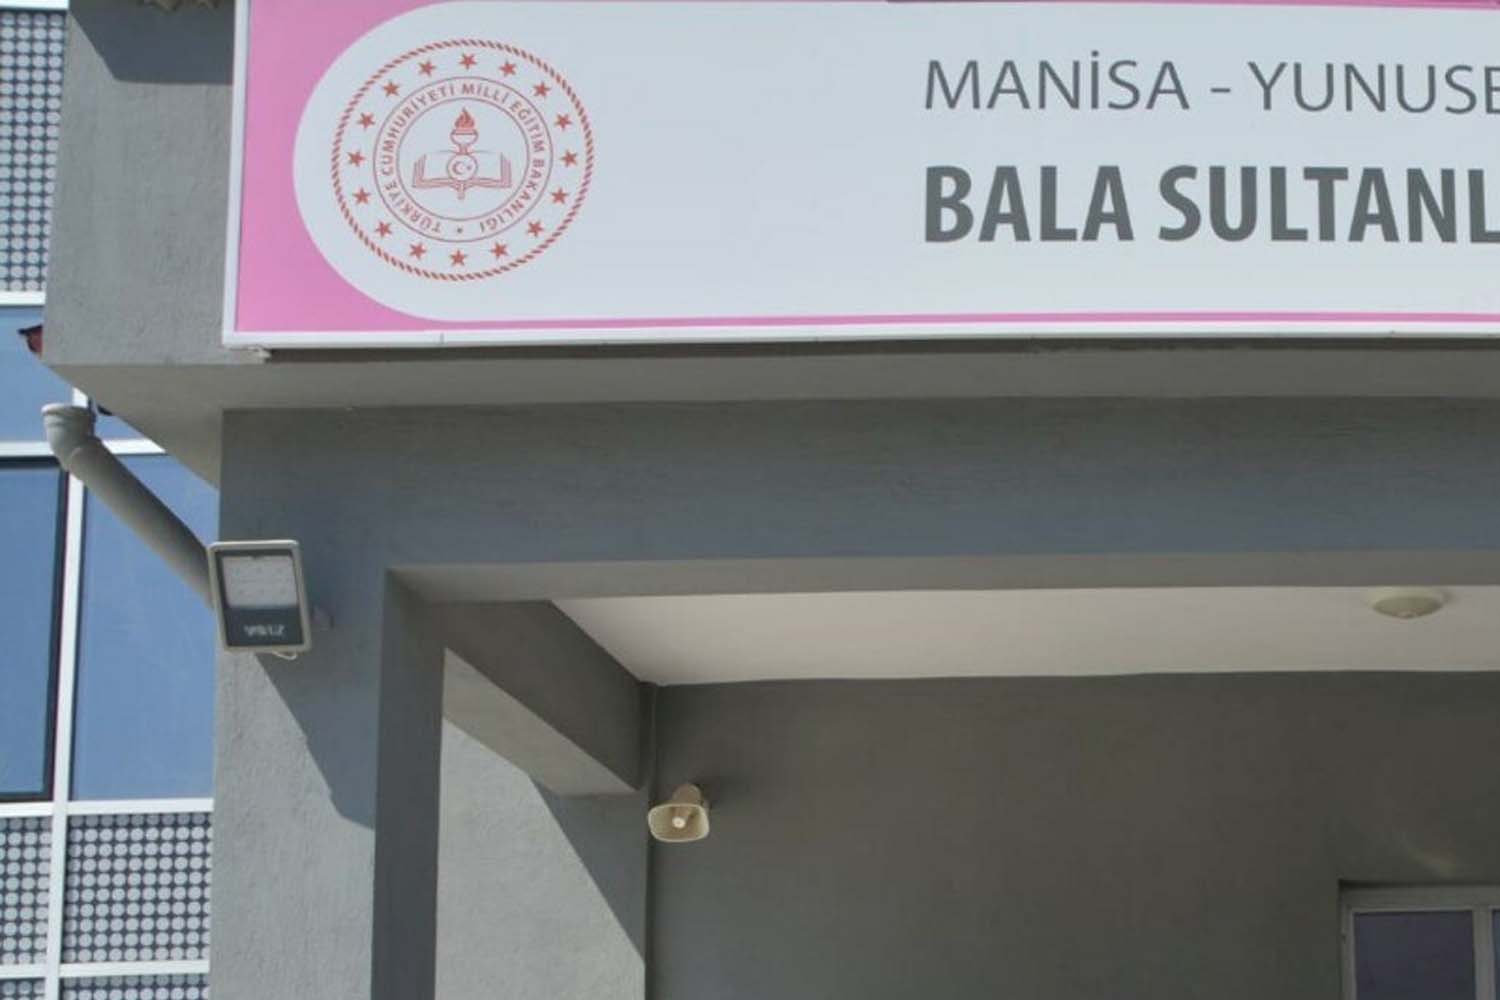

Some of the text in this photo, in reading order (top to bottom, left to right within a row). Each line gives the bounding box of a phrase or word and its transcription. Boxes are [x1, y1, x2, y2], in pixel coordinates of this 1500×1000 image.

[925, 49, 1190, 111] MANİSA
[382, 178, 442, 233] TÜRKİYE
[924, 165, 1135, 243] BALA
